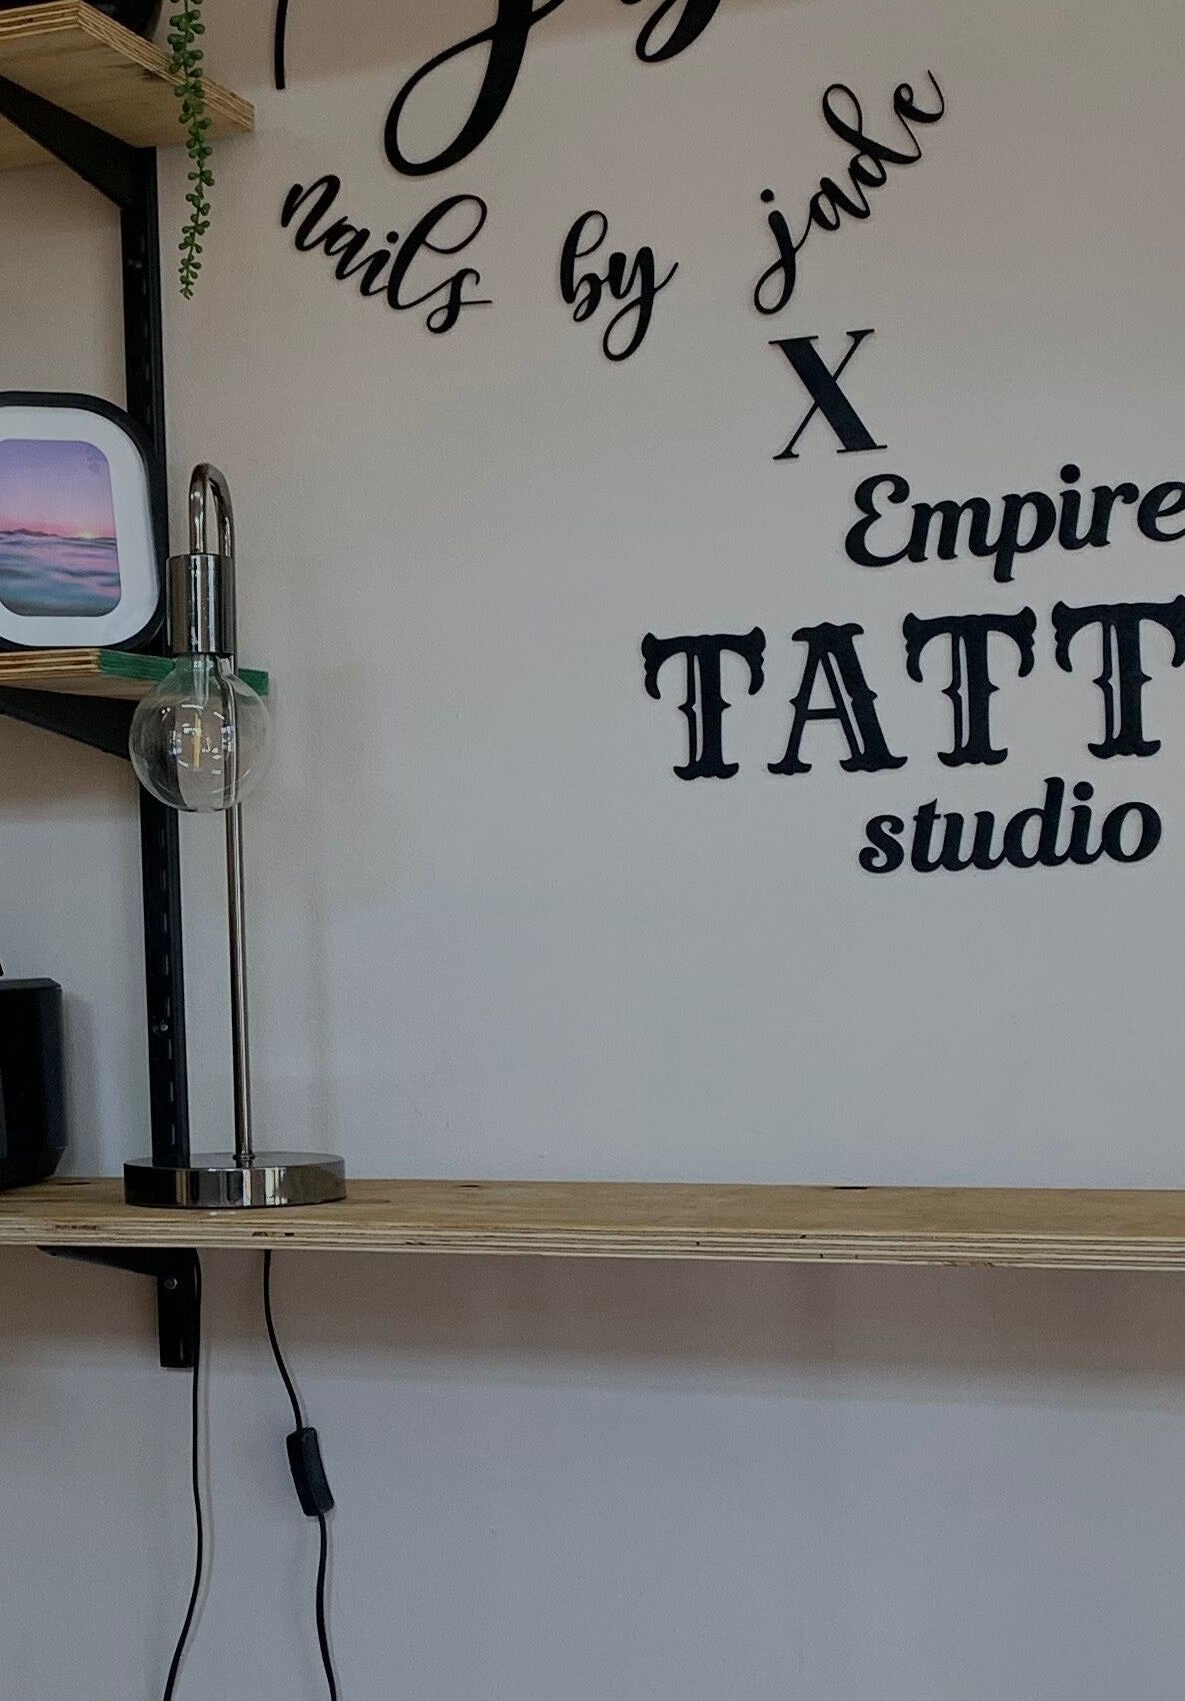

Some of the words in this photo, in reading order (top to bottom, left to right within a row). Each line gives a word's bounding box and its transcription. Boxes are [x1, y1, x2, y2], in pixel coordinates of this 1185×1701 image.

[560, 210, 679, 362] by
[754, 70, 945, 315] jade
[845, 464, 1185, 583] Empire
[858, 777, 1162, 874] studio
